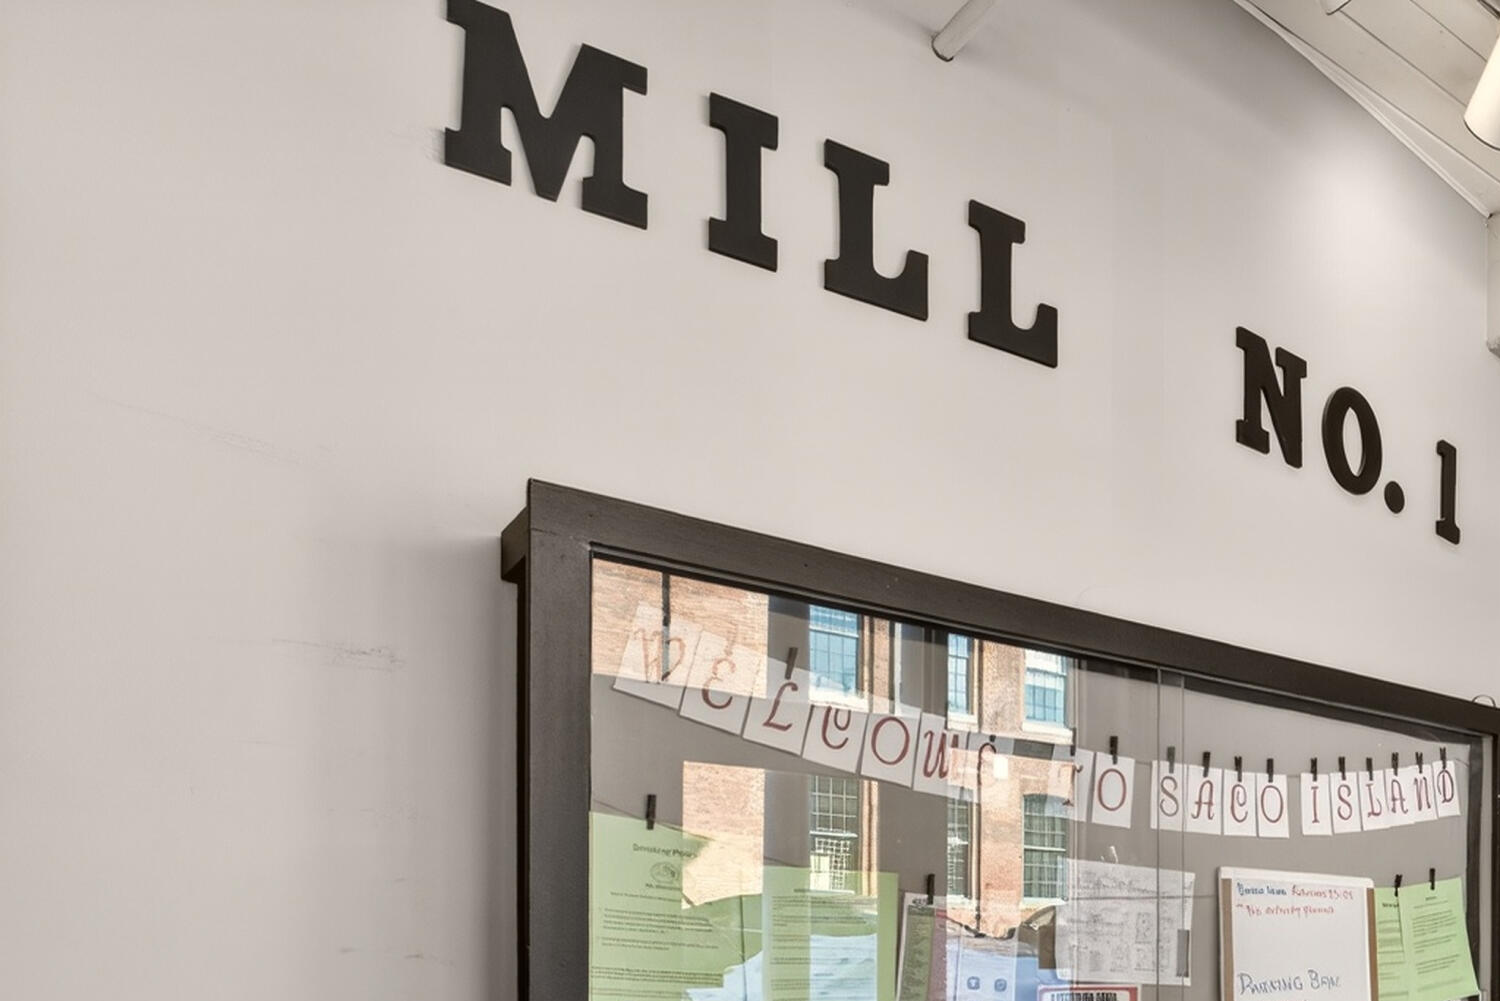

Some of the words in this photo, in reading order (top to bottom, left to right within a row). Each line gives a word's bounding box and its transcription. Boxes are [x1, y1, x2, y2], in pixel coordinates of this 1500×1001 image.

[444, 0, 1058, 368] MILL
[1236, 326, 1405, 514] NO.
[1435, 439, 1461, 545] 1
[1057, 764, 1127, 812] TO
[1159, 771, 1285, 824] SACO
[1310, 769, 1455, 824] ISLAND
